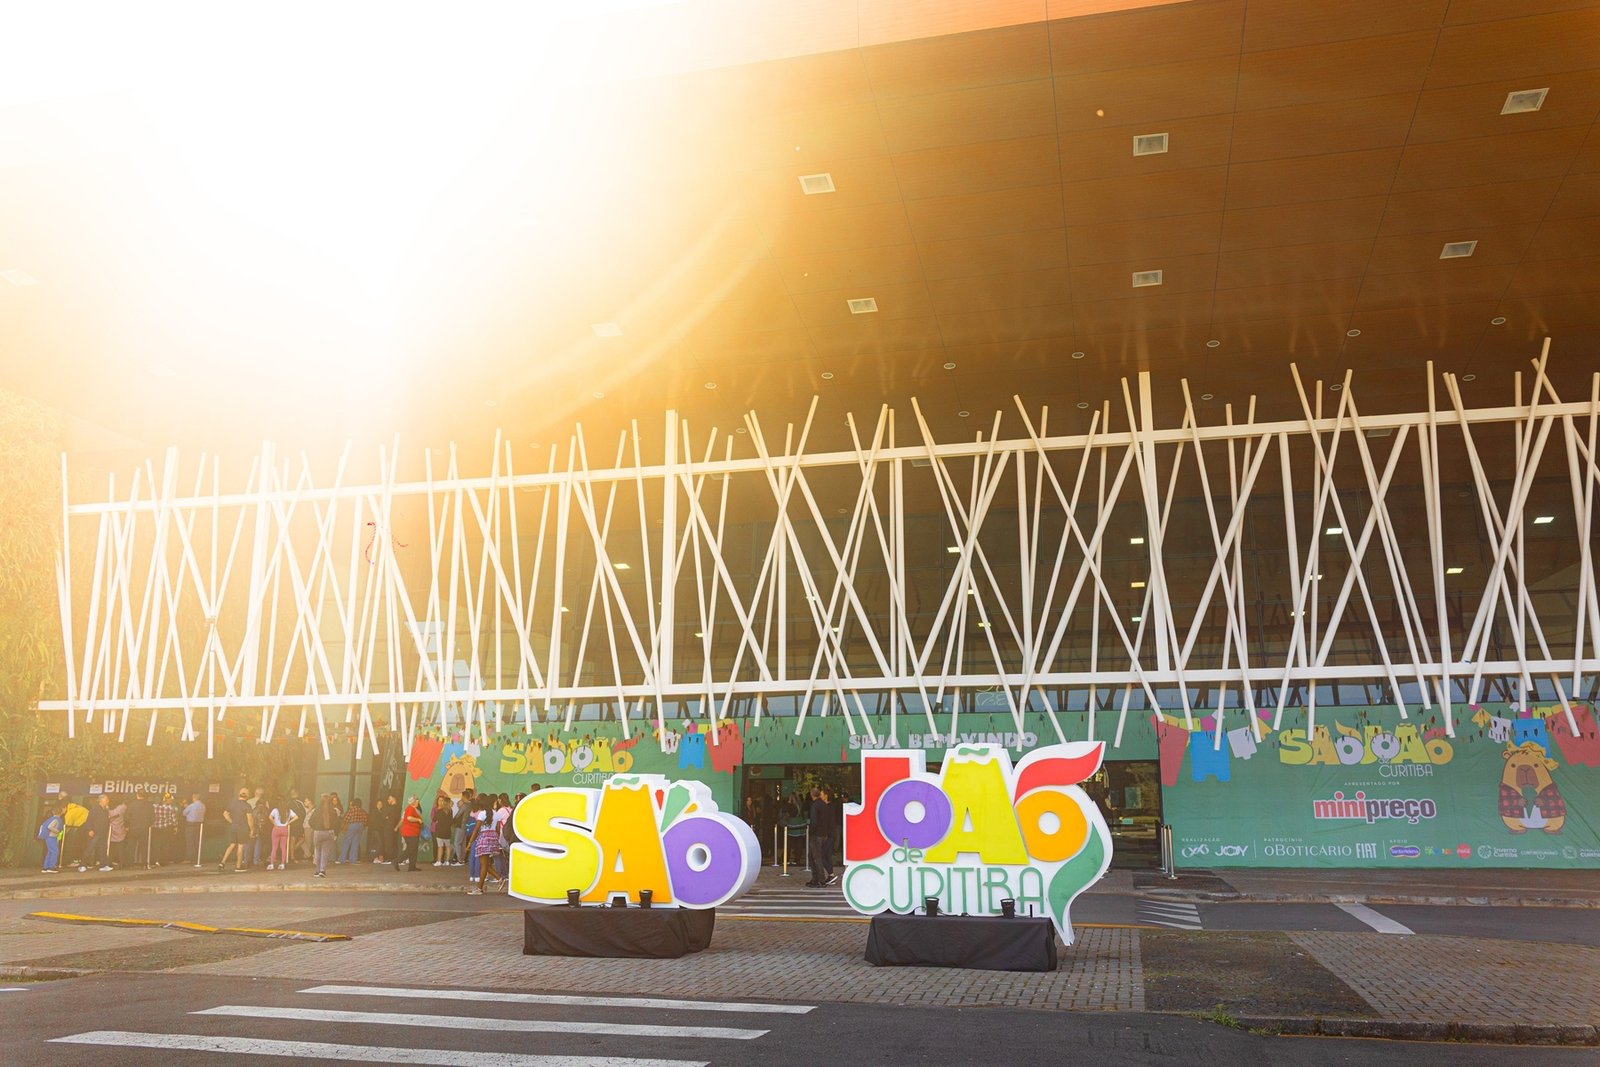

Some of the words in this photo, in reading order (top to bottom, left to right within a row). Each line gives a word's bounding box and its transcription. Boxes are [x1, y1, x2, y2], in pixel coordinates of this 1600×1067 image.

[849, 735, 901, 749] SEJA
[1378, 764, 1434, 778] CURITIBA
[104, 780, 178, 795] Bilheteria
[846, 746, 1088, 865] JOÃO
[1313, 790, 1437, 824] minipreço
[510, 776, 742, 905] SÃO
[892, 838, 923, 864] de
[1355, 843, 1377, 858] FIAT
[845, 863, 1046, 915] CURITIBA
